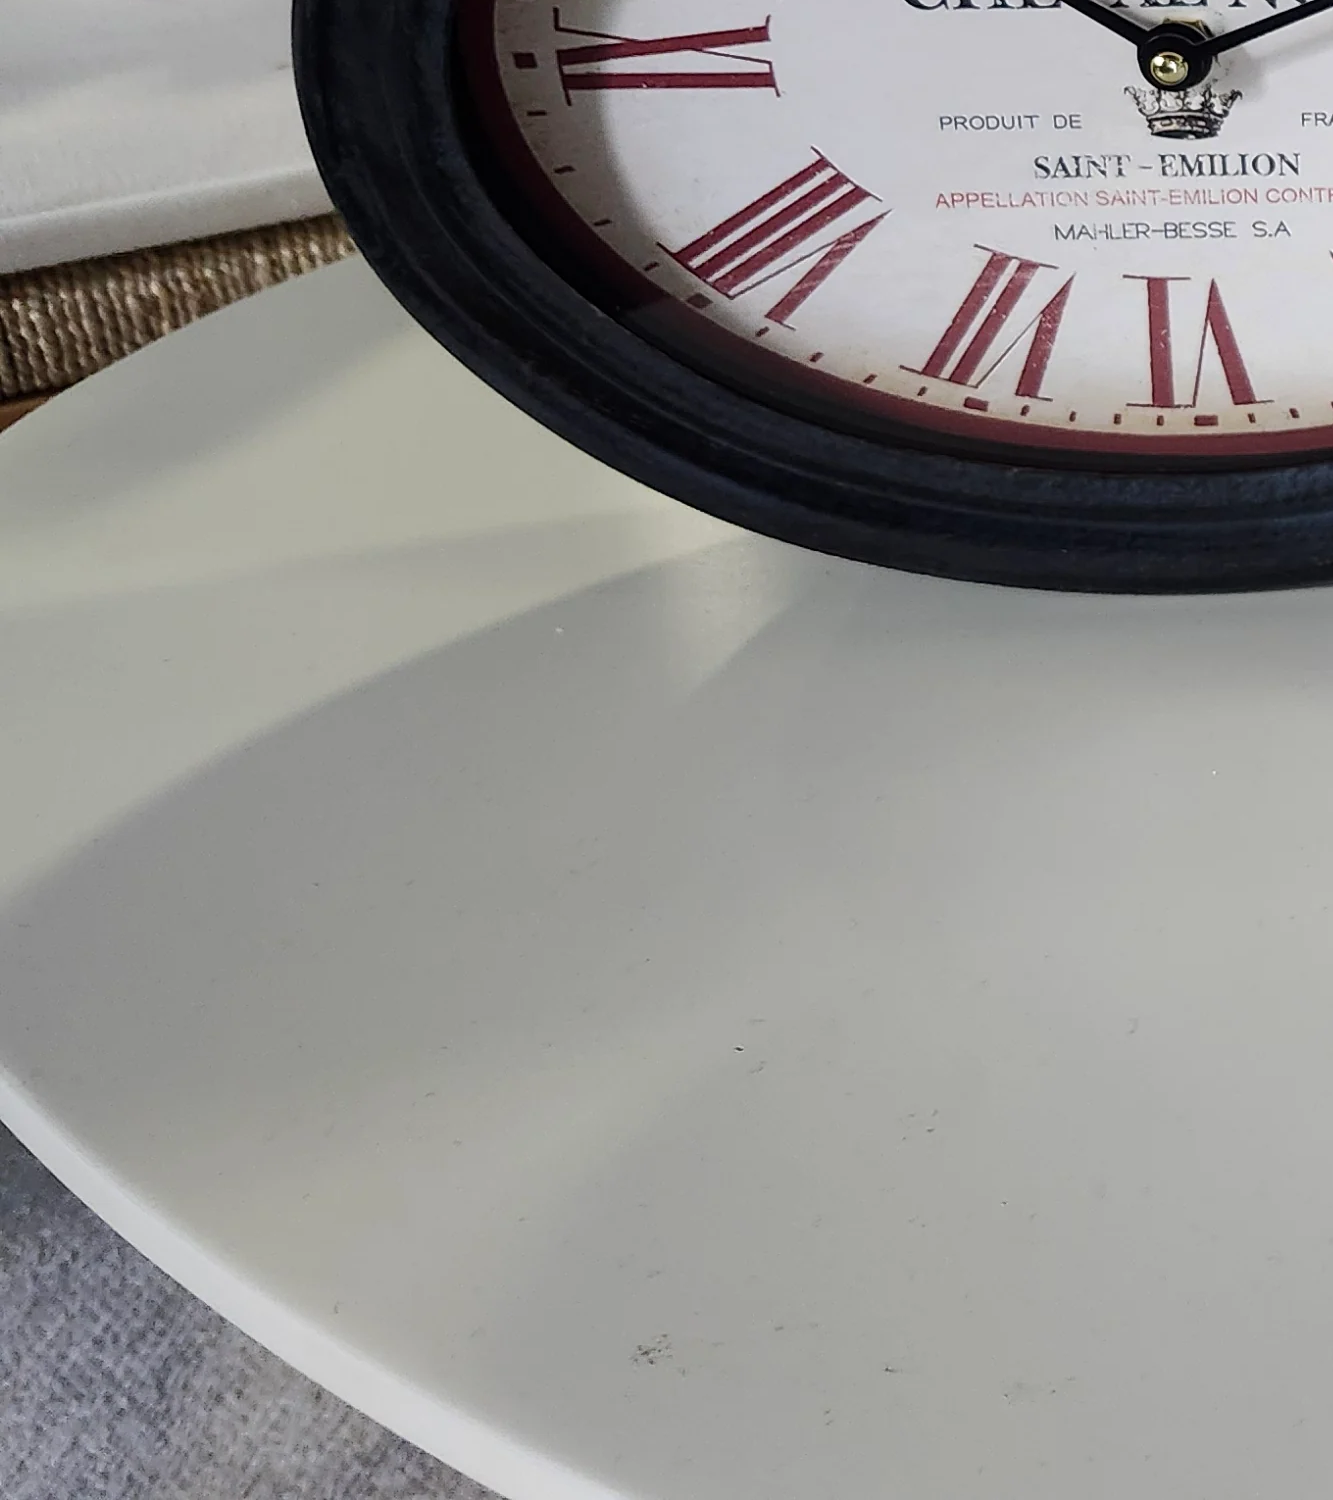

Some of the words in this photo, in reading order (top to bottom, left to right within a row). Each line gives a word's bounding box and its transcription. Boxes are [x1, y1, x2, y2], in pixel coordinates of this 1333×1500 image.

[553, 7, 782, 106] IX
[939, 114, 1040, 132] PRODUIT
[1053, 114, 1083, 130] DE
[935, 191, 1090, 210] APPELLATION
[1095, 189, 1260, 207] SAINT-EMILION
[1054, 220, 1237, 242] MAHLER-BESSE
[1252, 220, 1292, 239] S.A
